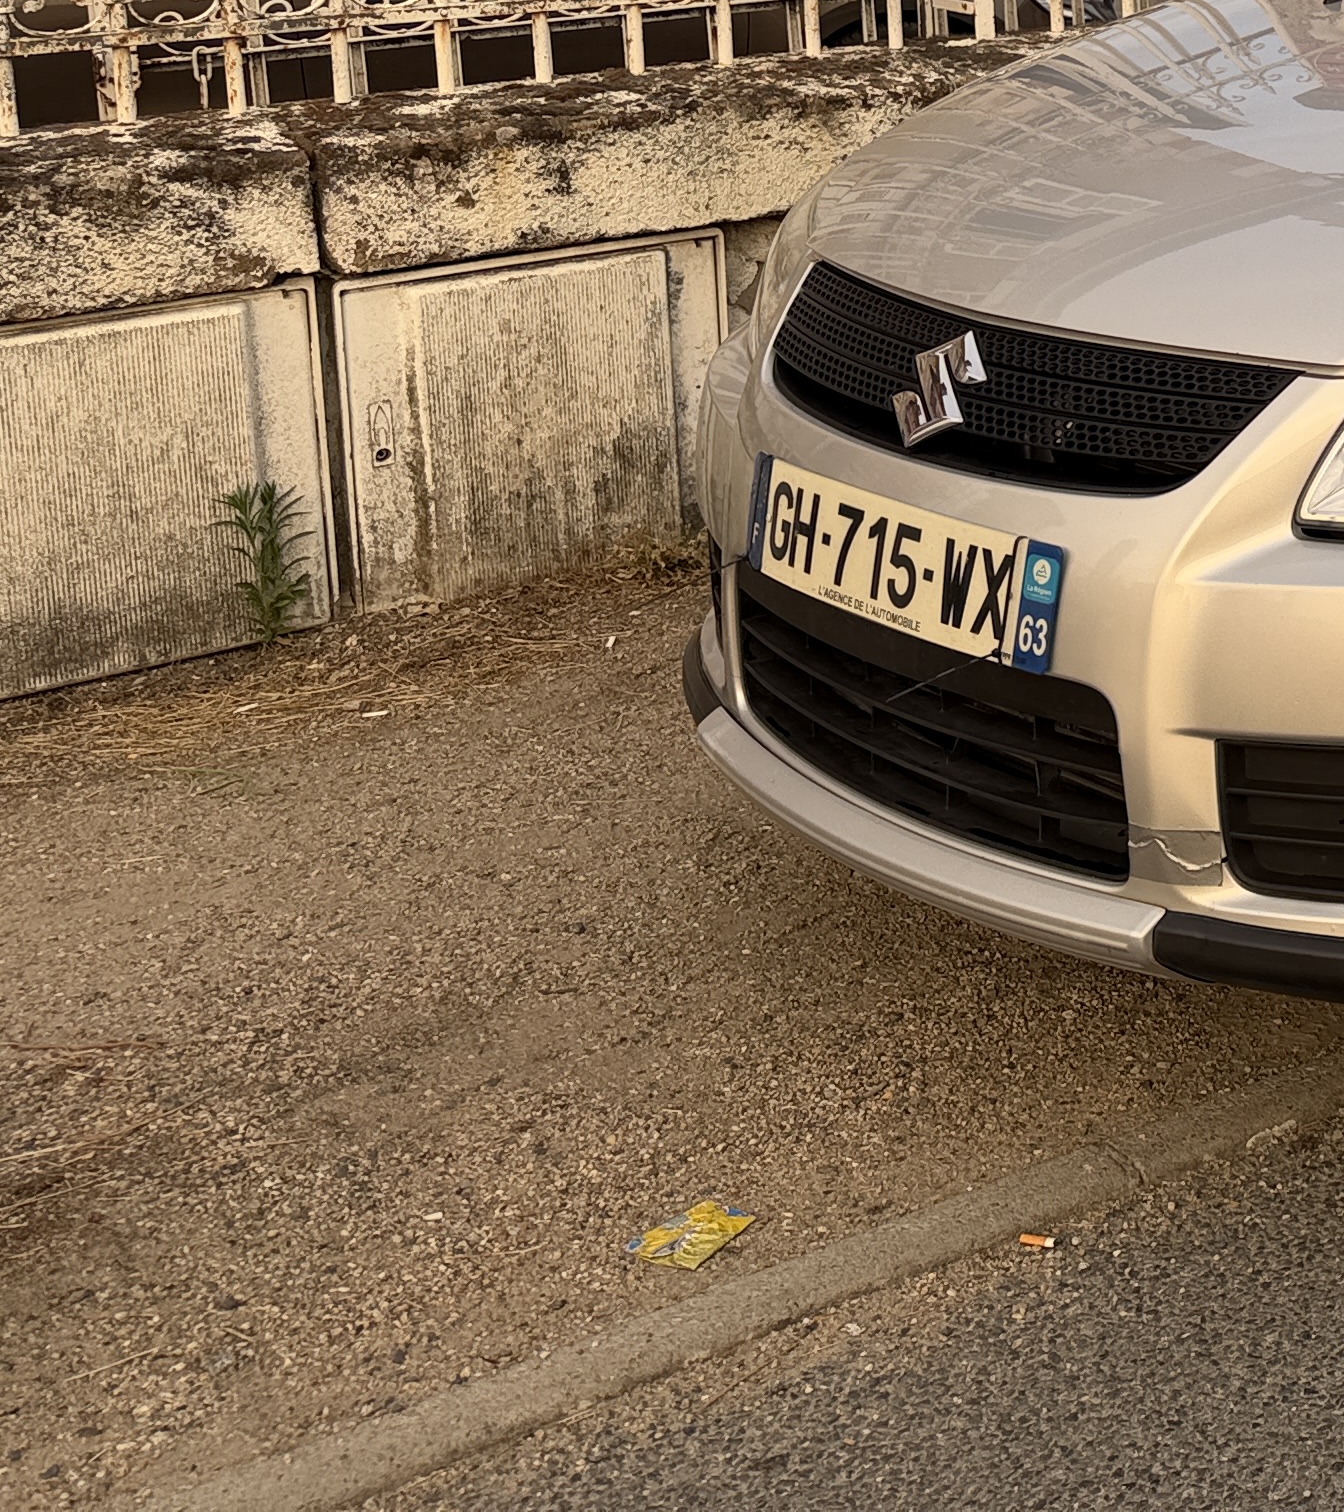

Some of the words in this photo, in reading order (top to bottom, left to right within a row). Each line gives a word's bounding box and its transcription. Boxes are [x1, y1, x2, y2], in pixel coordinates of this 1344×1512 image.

[752, 521, 760, 544] F
[769, 480, 1014, 641] GH-715-WX
[818, 585, 853, 608] L'AGENCE
[854, 598, 864, 612] DE
[866, 603, 921, 633] L'AUTOMOBILE
[1019, 614, 1048, 657] 63
